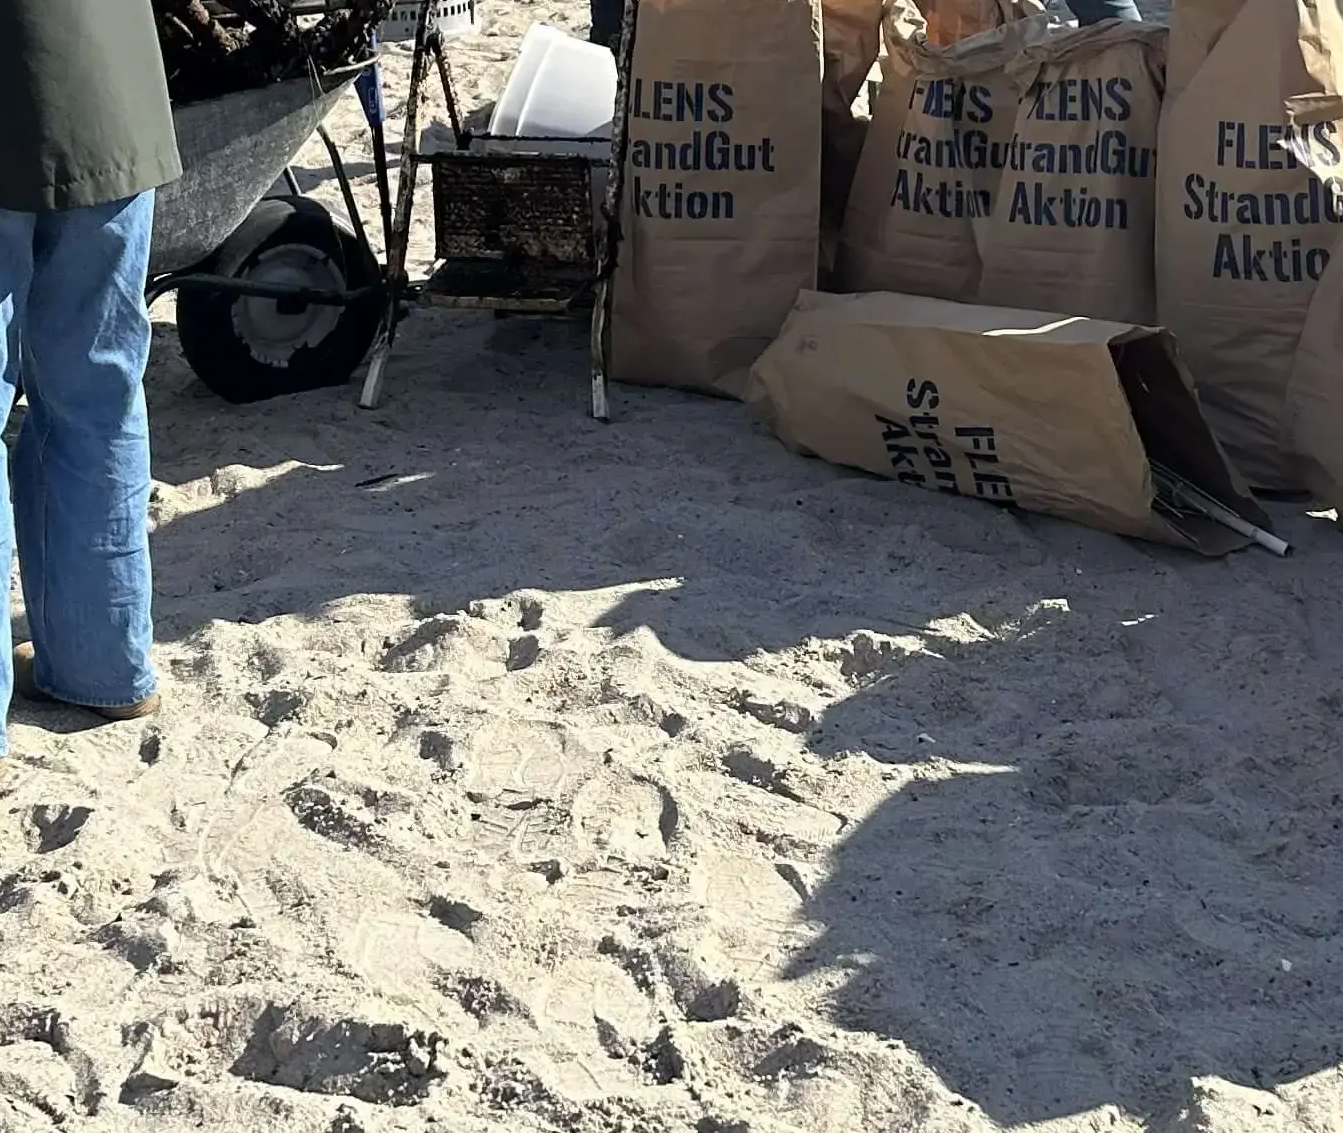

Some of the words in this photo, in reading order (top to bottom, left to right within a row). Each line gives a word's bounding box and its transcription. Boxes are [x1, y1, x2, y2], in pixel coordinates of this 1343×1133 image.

[630, 79, 734, 122] LENS
[630, 130, 775, 172] andGut
[1217, 120, 1342, 170] FLENS
[632, 176, 734, 219] ktion
[1213, 234, 1328, 282] Aktio
[955, 427, 1013, 496] FLE
